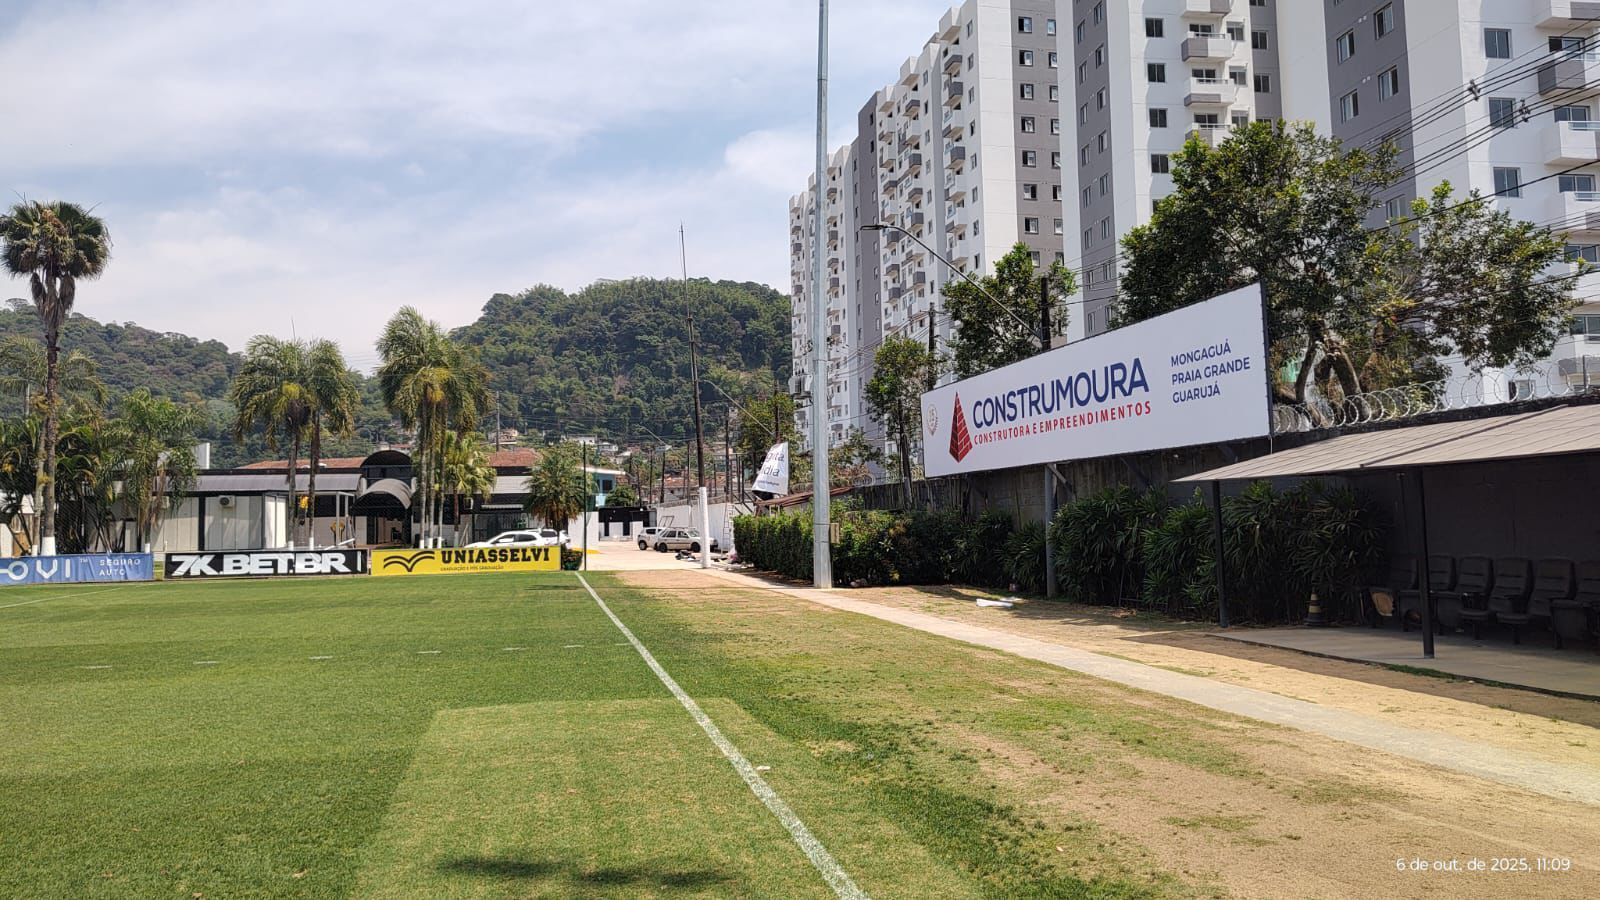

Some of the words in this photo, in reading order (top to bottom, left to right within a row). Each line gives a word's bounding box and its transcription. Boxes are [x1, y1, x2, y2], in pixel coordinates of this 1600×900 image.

[1170, 338, 1232, 367] MONGAGUÁ
[1171, 368, 1202, 385] PRAIA
[1203, 356, 1251, 379] GRANDE
[972, 357, 1150, 428] CONSTRUMOURA
[1172, 380, 1221, 404] GUARUJÁ
[973, 424, 1031, 446] CONSTRUTORA
[1032, 422, 1038, 435] E
[1039, 400, 1152, 433] EMPREENDIMENTOS
[99, 558, 141, 566] SEGURO
[440, 547, 550, 564] UNIASSELVI
[99, 568, 126, 576] AUTO
